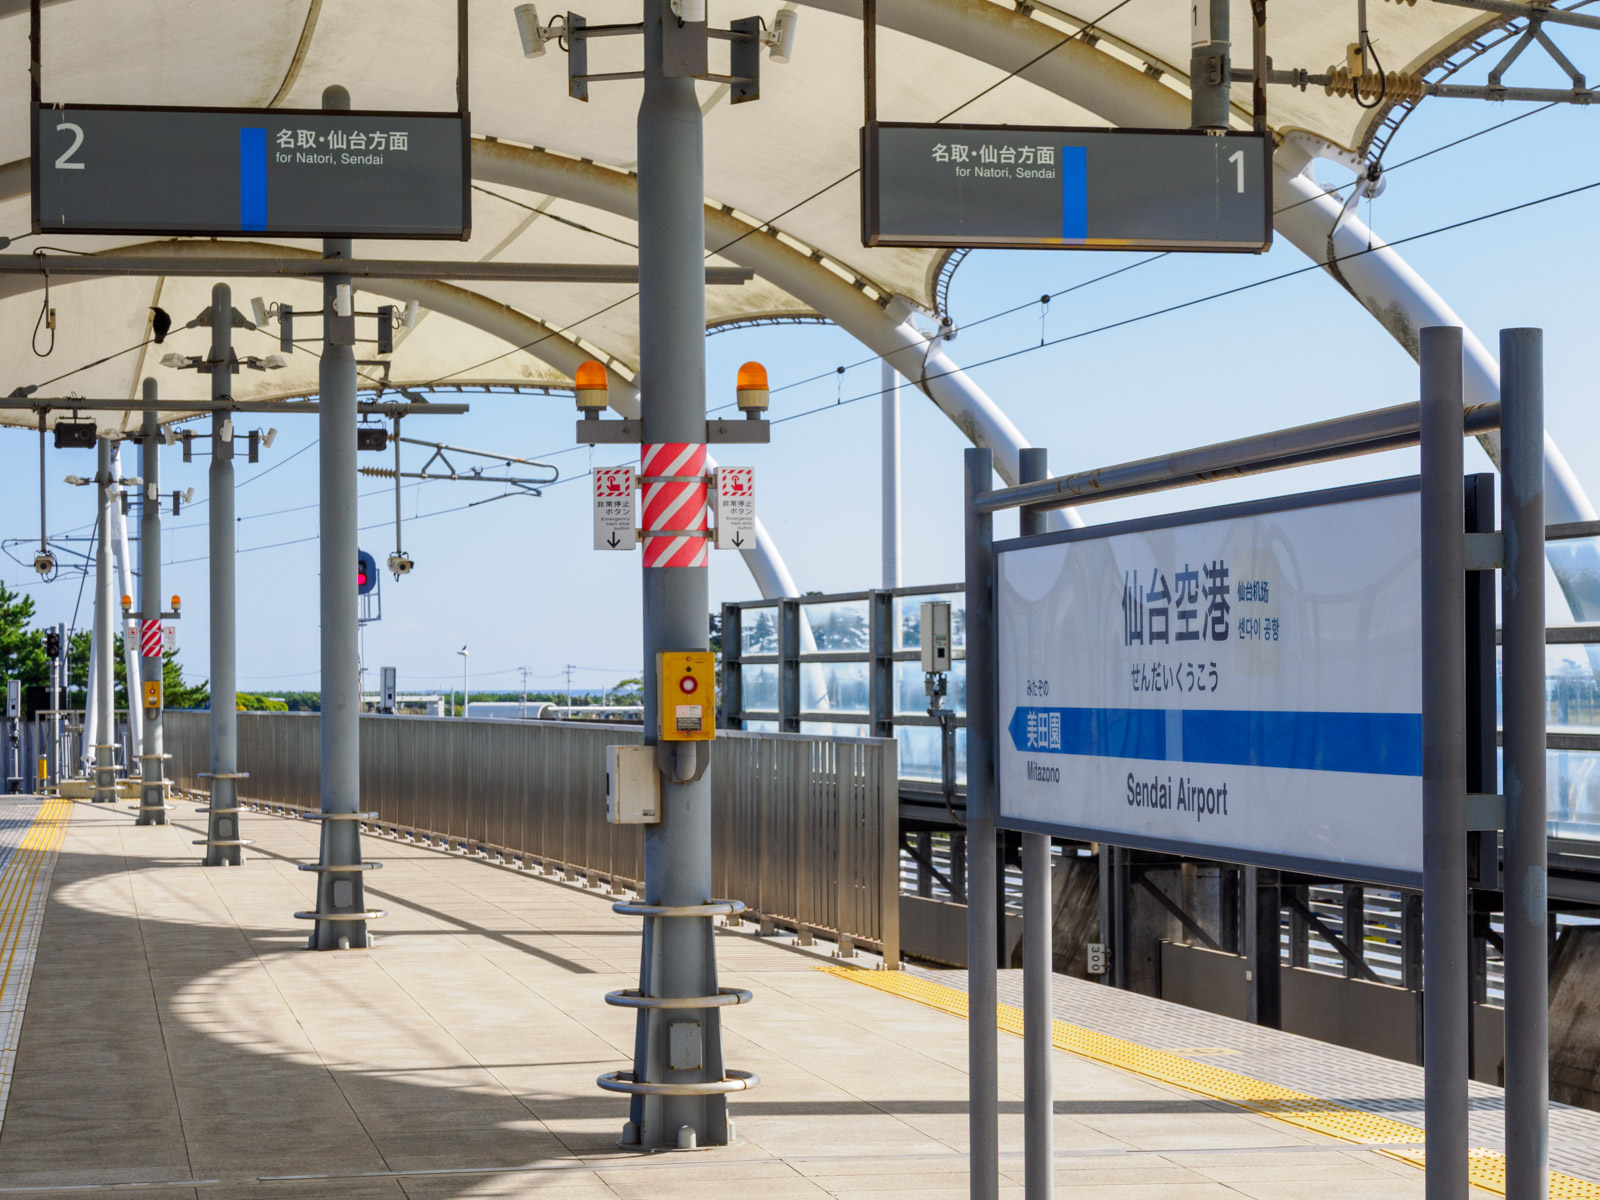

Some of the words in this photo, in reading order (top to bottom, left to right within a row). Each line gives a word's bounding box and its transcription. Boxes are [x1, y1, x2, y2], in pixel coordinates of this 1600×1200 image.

[55, 122, 85, 169] 2
[276, 128, 409, 151] 名取・仙台方面
[276, 152, 292, 163] for
[296, 153, 336, 165] Natori,
[341, 153, 384, 165] Sendai
[931, 143, 1055, 165] 名取・仙台方面
[955, 166, 971, 177] for
[975, 167, 1012, 178] Natori,
[1016, 167, 1056, 178] Sendai
[1228, 150, 1244, 193] 1
[1121, 560, 1231, 647] 仙台空港
[1237, 580, 1269, 603] 仙台机场
[1238, 617, 1261, 641] 센다이
[1264, 617, 1280, 641] 공항
[1026, 679, 1050, 697] みたぞの
[1131, 661, 1219, 692] せんだいくうこう
[1026, 711, 1061, 750] 美田園
[1027, 760, 1060, 783] Mitazono
[1126, 772, 1171, 810] Sendai
[1177, 777, 1228, 822] Airport
[1091, 946, 1100, 971] 300
